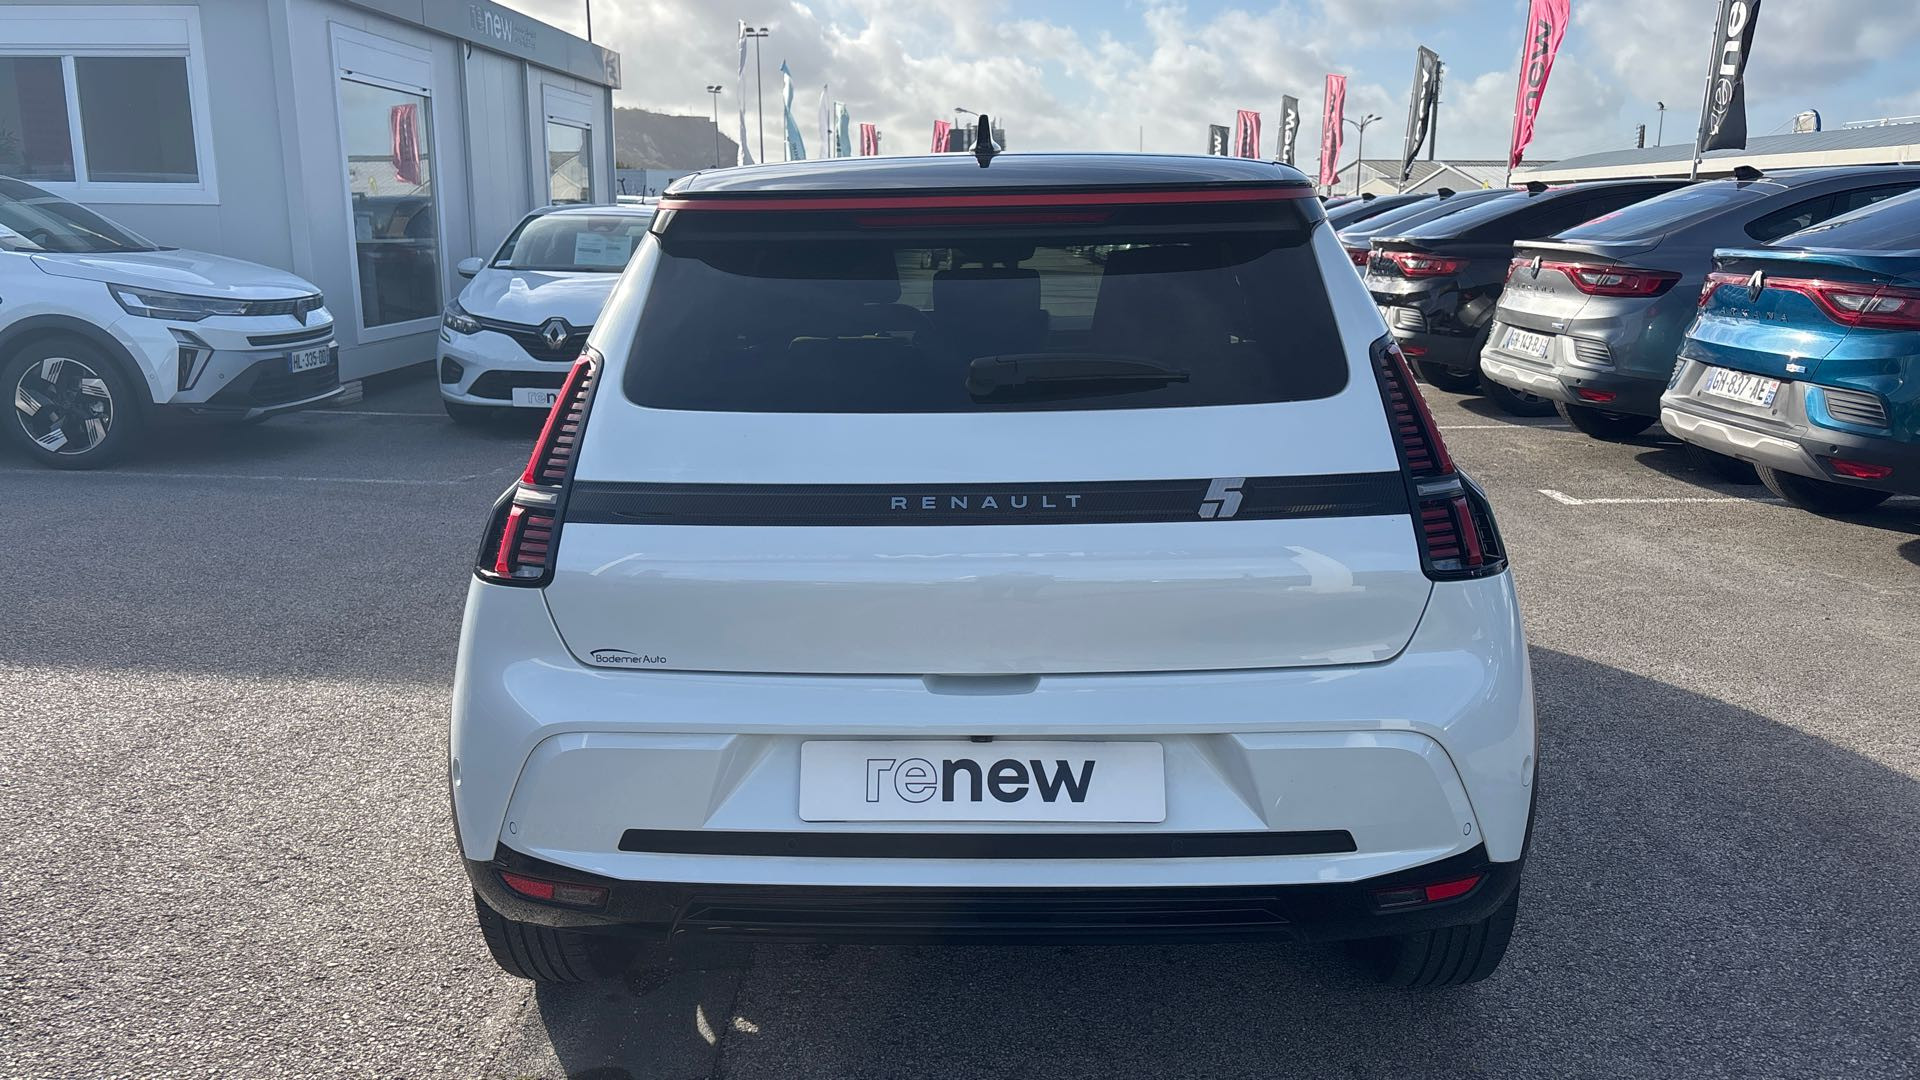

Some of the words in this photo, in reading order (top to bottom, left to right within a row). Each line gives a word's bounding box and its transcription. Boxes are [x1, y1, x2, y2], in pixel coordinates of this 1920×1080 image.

[1525, 19, 1552, 116] new
[1282, 108, 1296, 160] new
[1720, 306, 1789, 323] ARKANA
[1712, 370, 1769, 401] GH-837-AE
[890, 494, 1082, 511] RENAULT
[1197, 477, 1246, 519] 5
[865, 757, 1096, 804] renew
